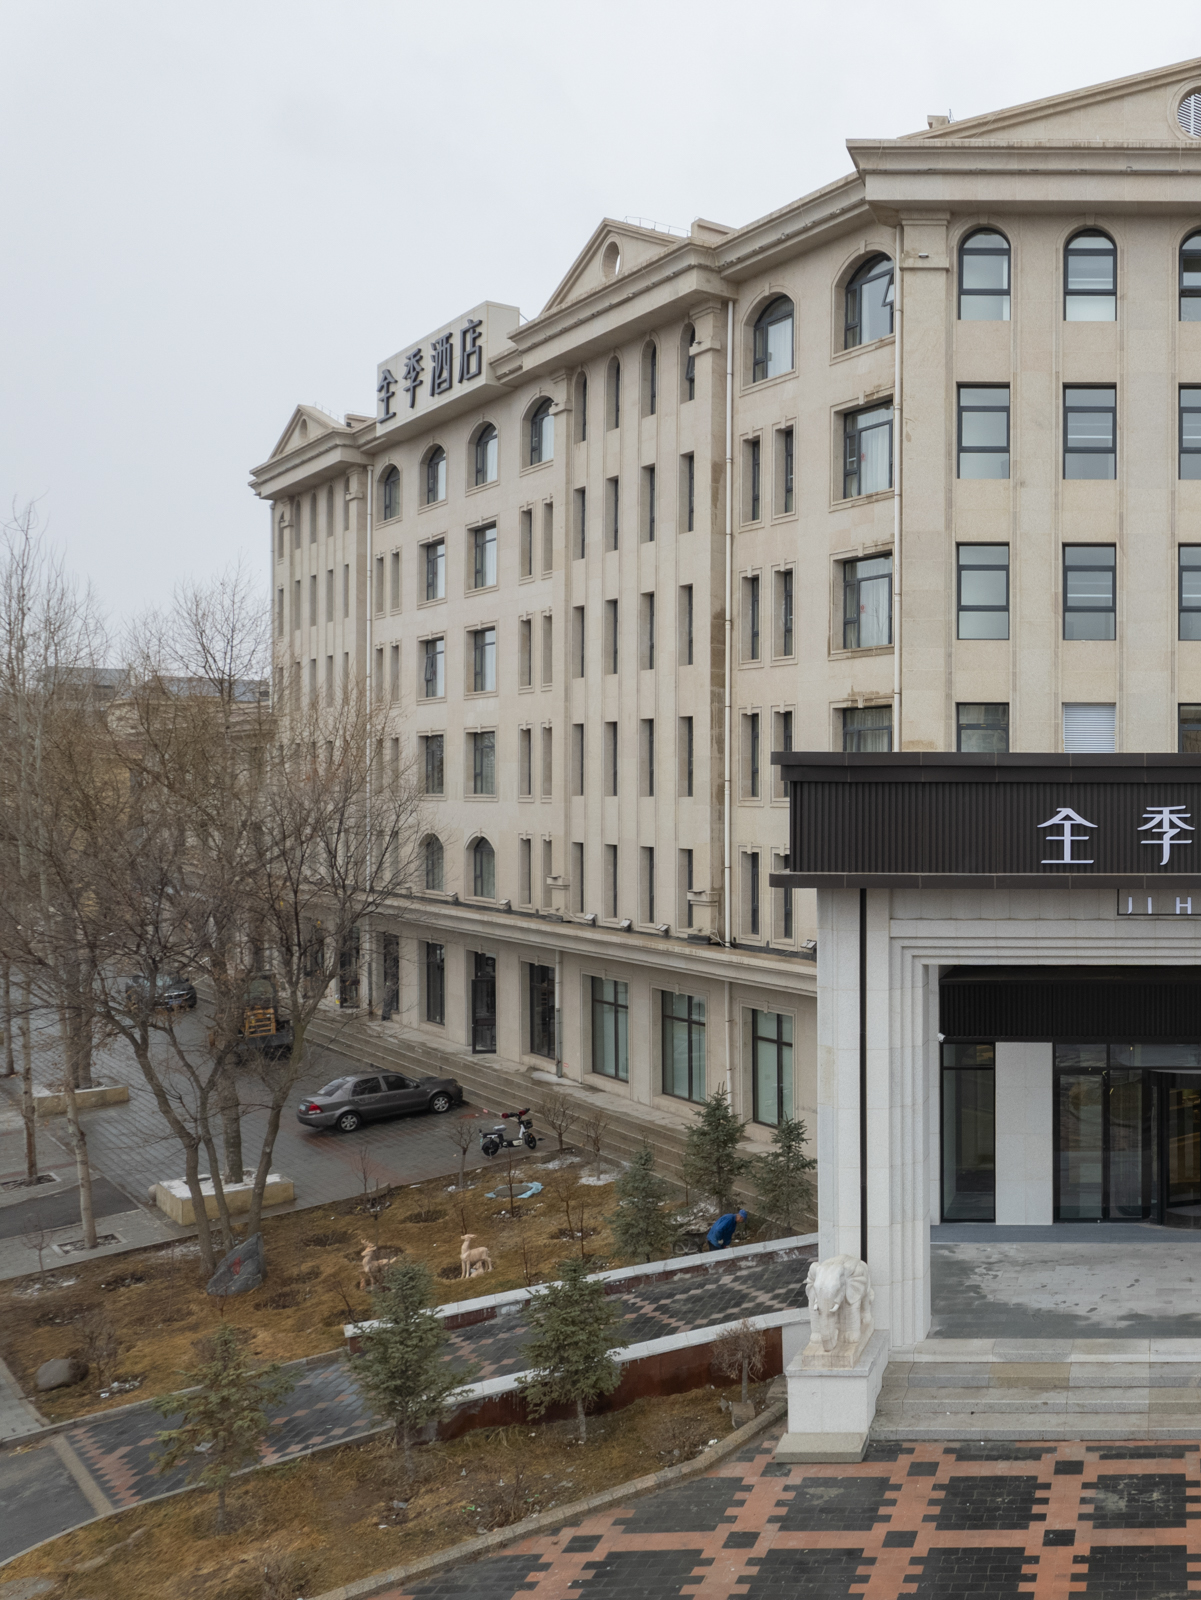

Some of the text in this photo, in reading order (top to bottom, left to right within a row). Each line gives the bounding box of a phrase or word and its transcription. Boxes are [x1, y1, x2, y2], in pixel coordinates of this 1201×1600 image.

[376, 318, 483, 424] 全季酒店
[1127, 896, 1153, 915] JI
